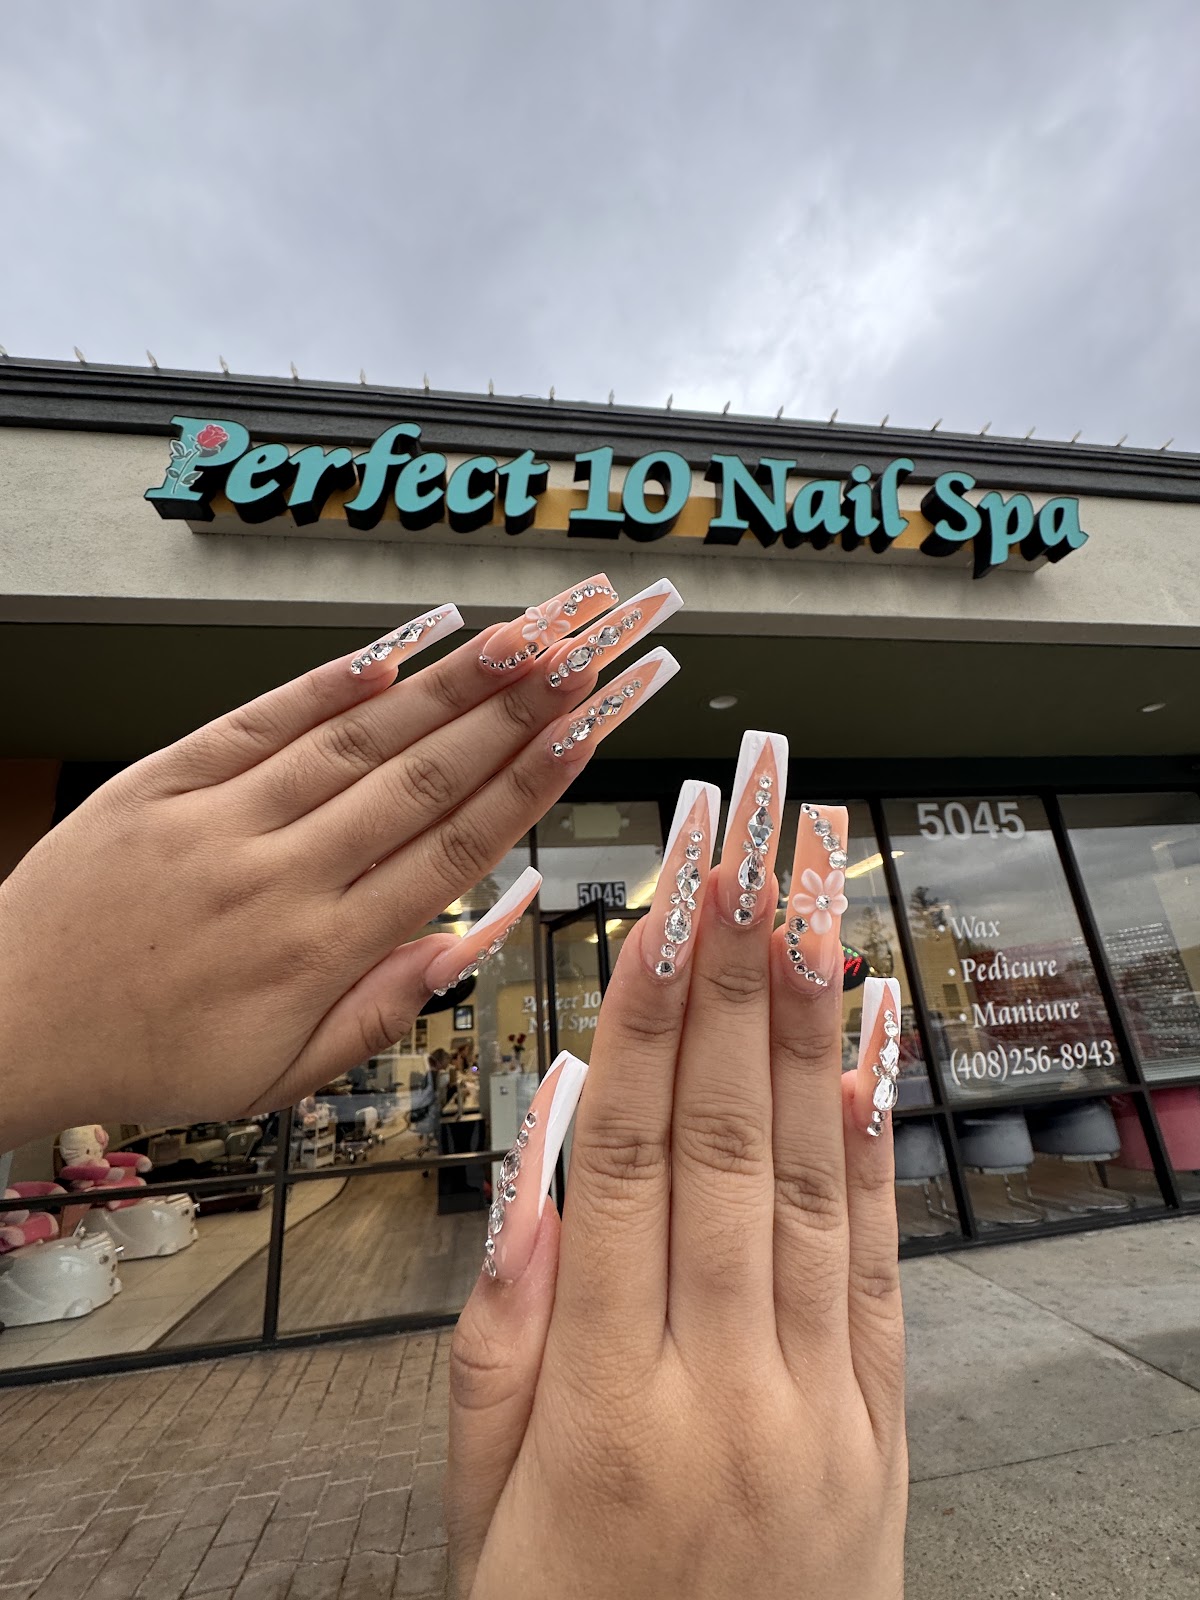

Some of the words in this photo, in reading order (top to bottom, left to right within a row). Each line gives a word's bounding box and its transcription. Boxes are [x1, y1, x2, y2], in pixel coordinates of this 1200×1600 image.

[144, 414, 550, 517] Perfect
[568, 445, 692, 525] 10
[711, 453, 915, 539] Nail
[934, 471, 1090, 566] Spa
[917, 801, 1026, 841] 5045
[579, 882, 625, 907] 5045
[950, 915, 1001, 940] Wax
[960, 951, 1058, 984] Pedicure
[583, 991, 602, 1008] 10
[971, 998, 1081, 1029] Manicure
[950, 1040, 1116, 1086] (408)256-8943
